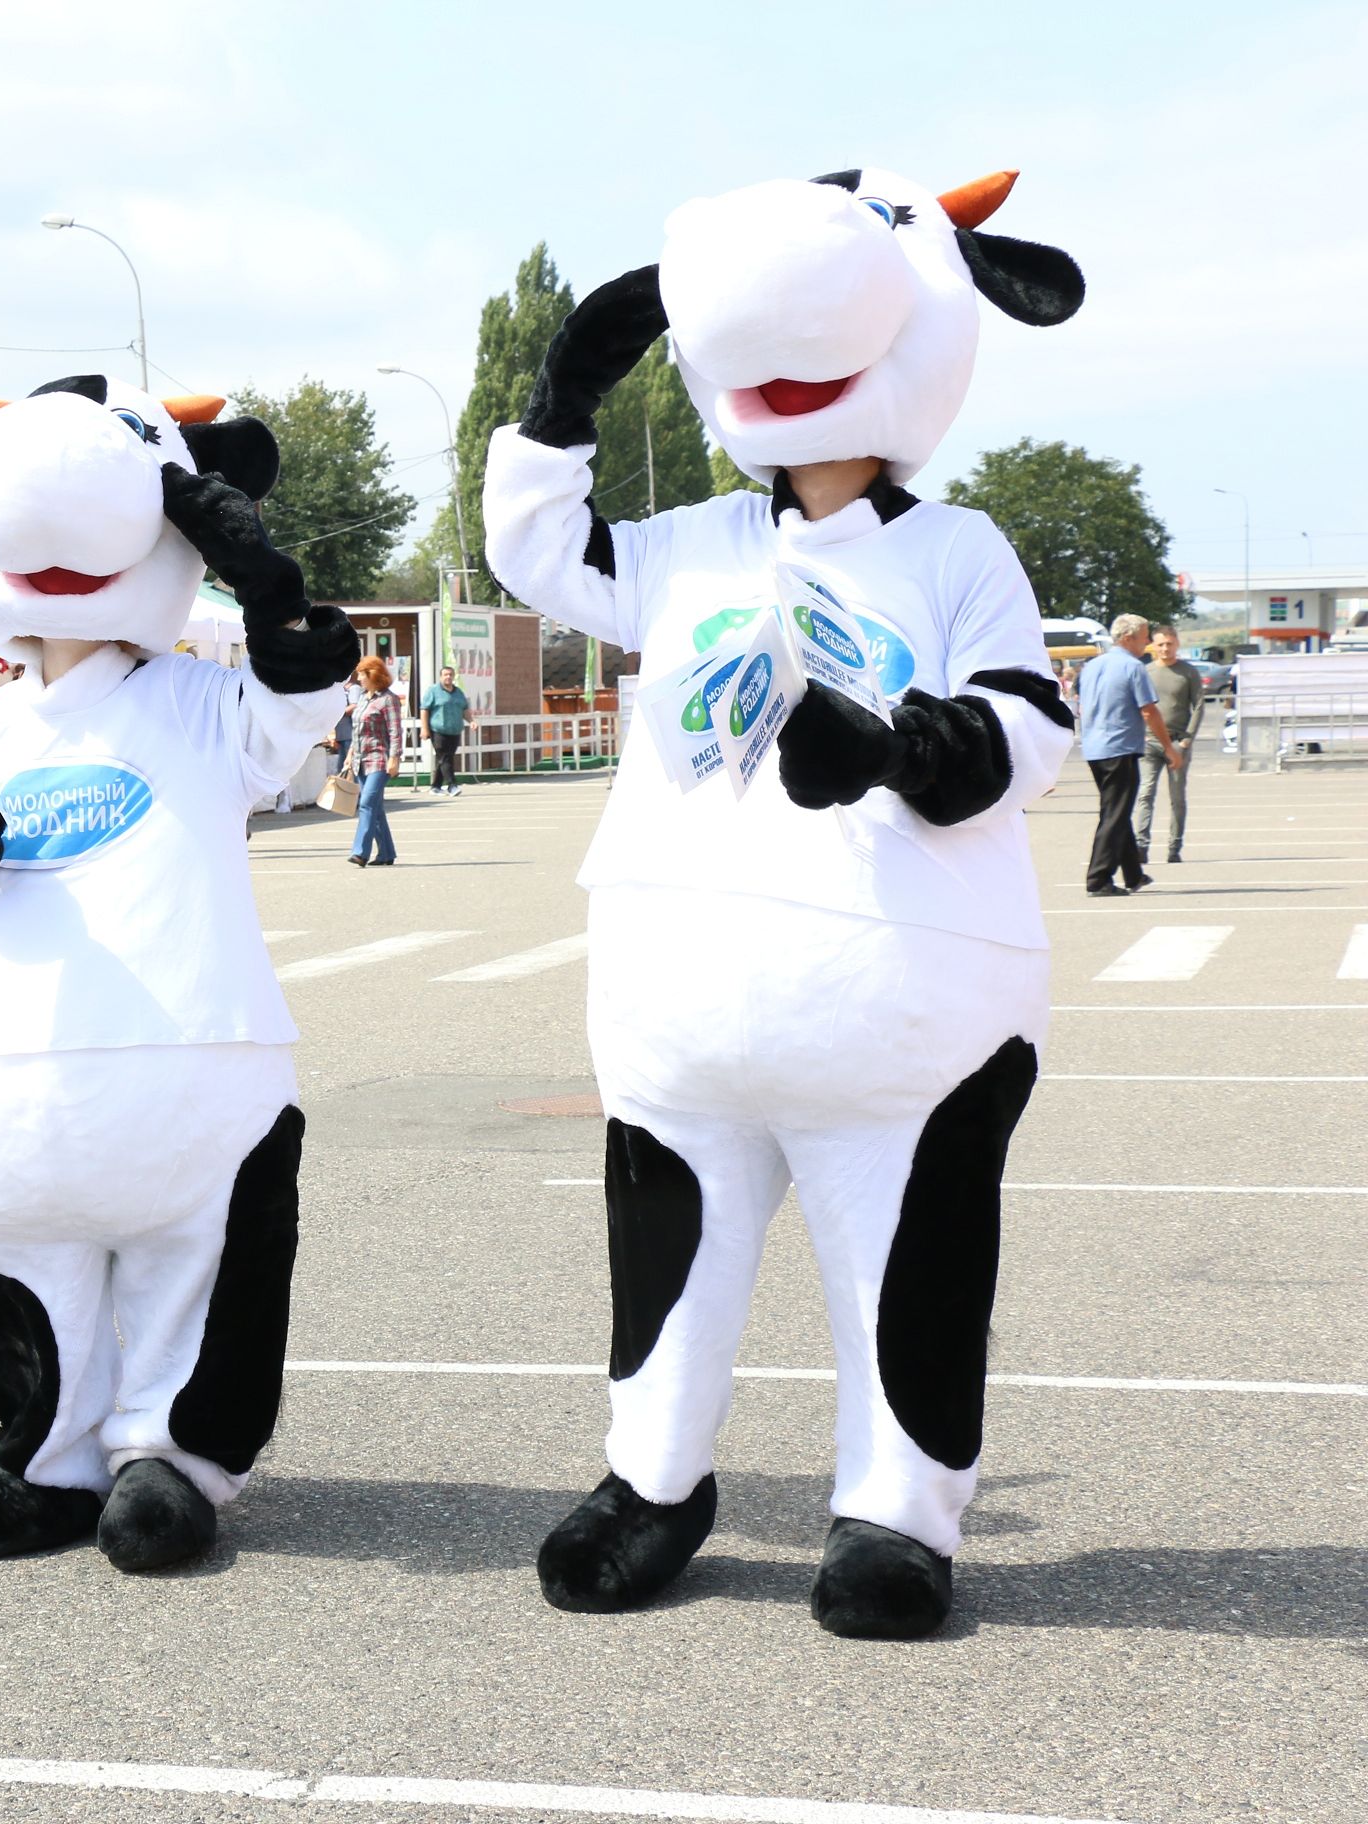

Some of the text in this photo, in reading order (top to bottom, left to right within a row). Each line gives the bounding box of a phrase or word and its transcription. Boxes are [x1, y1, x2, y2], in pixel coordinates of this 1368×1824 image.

[1294, 600, 1304, 619] 1
[815, 628, 861, 666] РОДНИК
[742, 668, 770, 719] РОДНИК
[5, 777, 126, 813] МОЛОЧНЫЙ
[7, 800, 127, 840] РОДНИК
